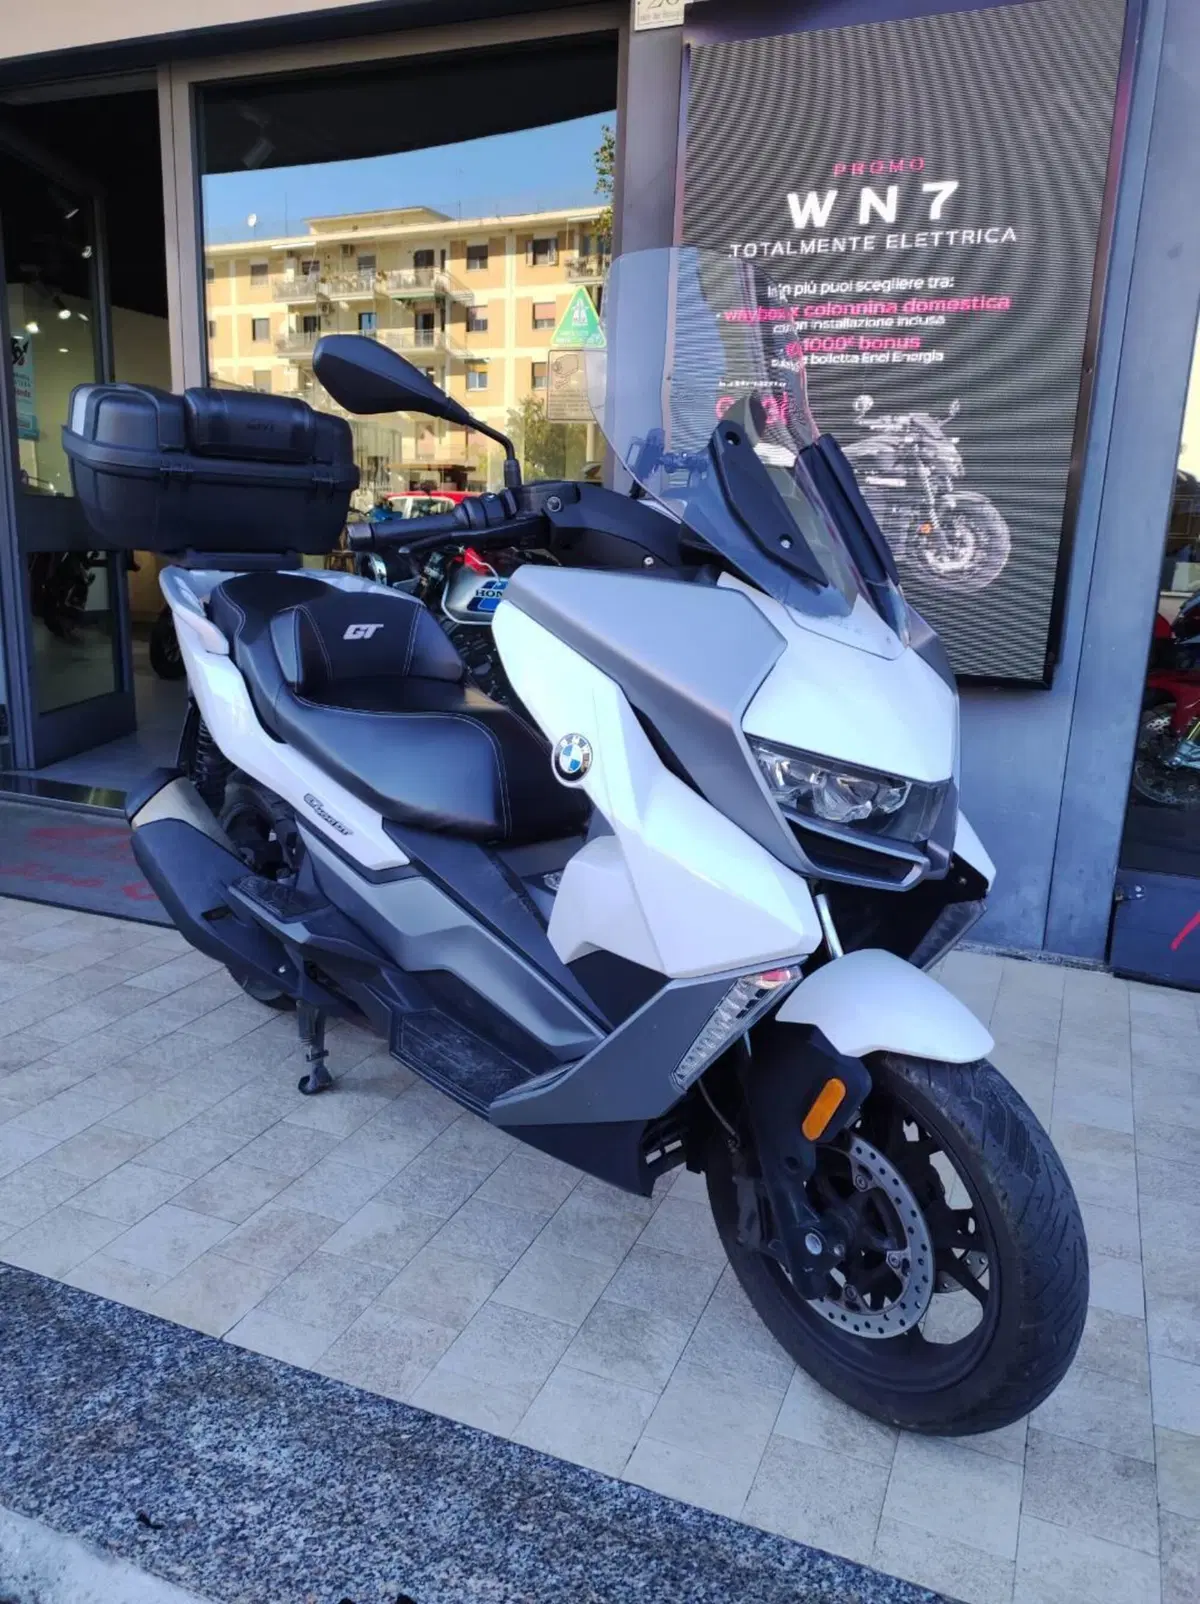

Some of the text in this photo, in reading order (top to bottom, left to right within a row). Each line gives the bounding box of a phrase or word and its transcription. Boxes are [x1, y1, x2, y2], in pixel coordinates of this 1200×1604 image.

[833, 157, 925, 176] PROMO
[729, 227, 1017, 257] TOTALMENTE ELETTRICA
[820, 280, 853, 296] puoi
[856, 276, 925, 293] scegliere
[804, 301, 898, 318] colonnina
[902, 296, 1011, 312] domestica
[811, 316, 894, 331] installazione
[897, 315, 946, 327] inclusa
[859, 336, 922, 350] bonus
[475, 589, 504, 598] HON
[343, 624, 385, 640] GT
